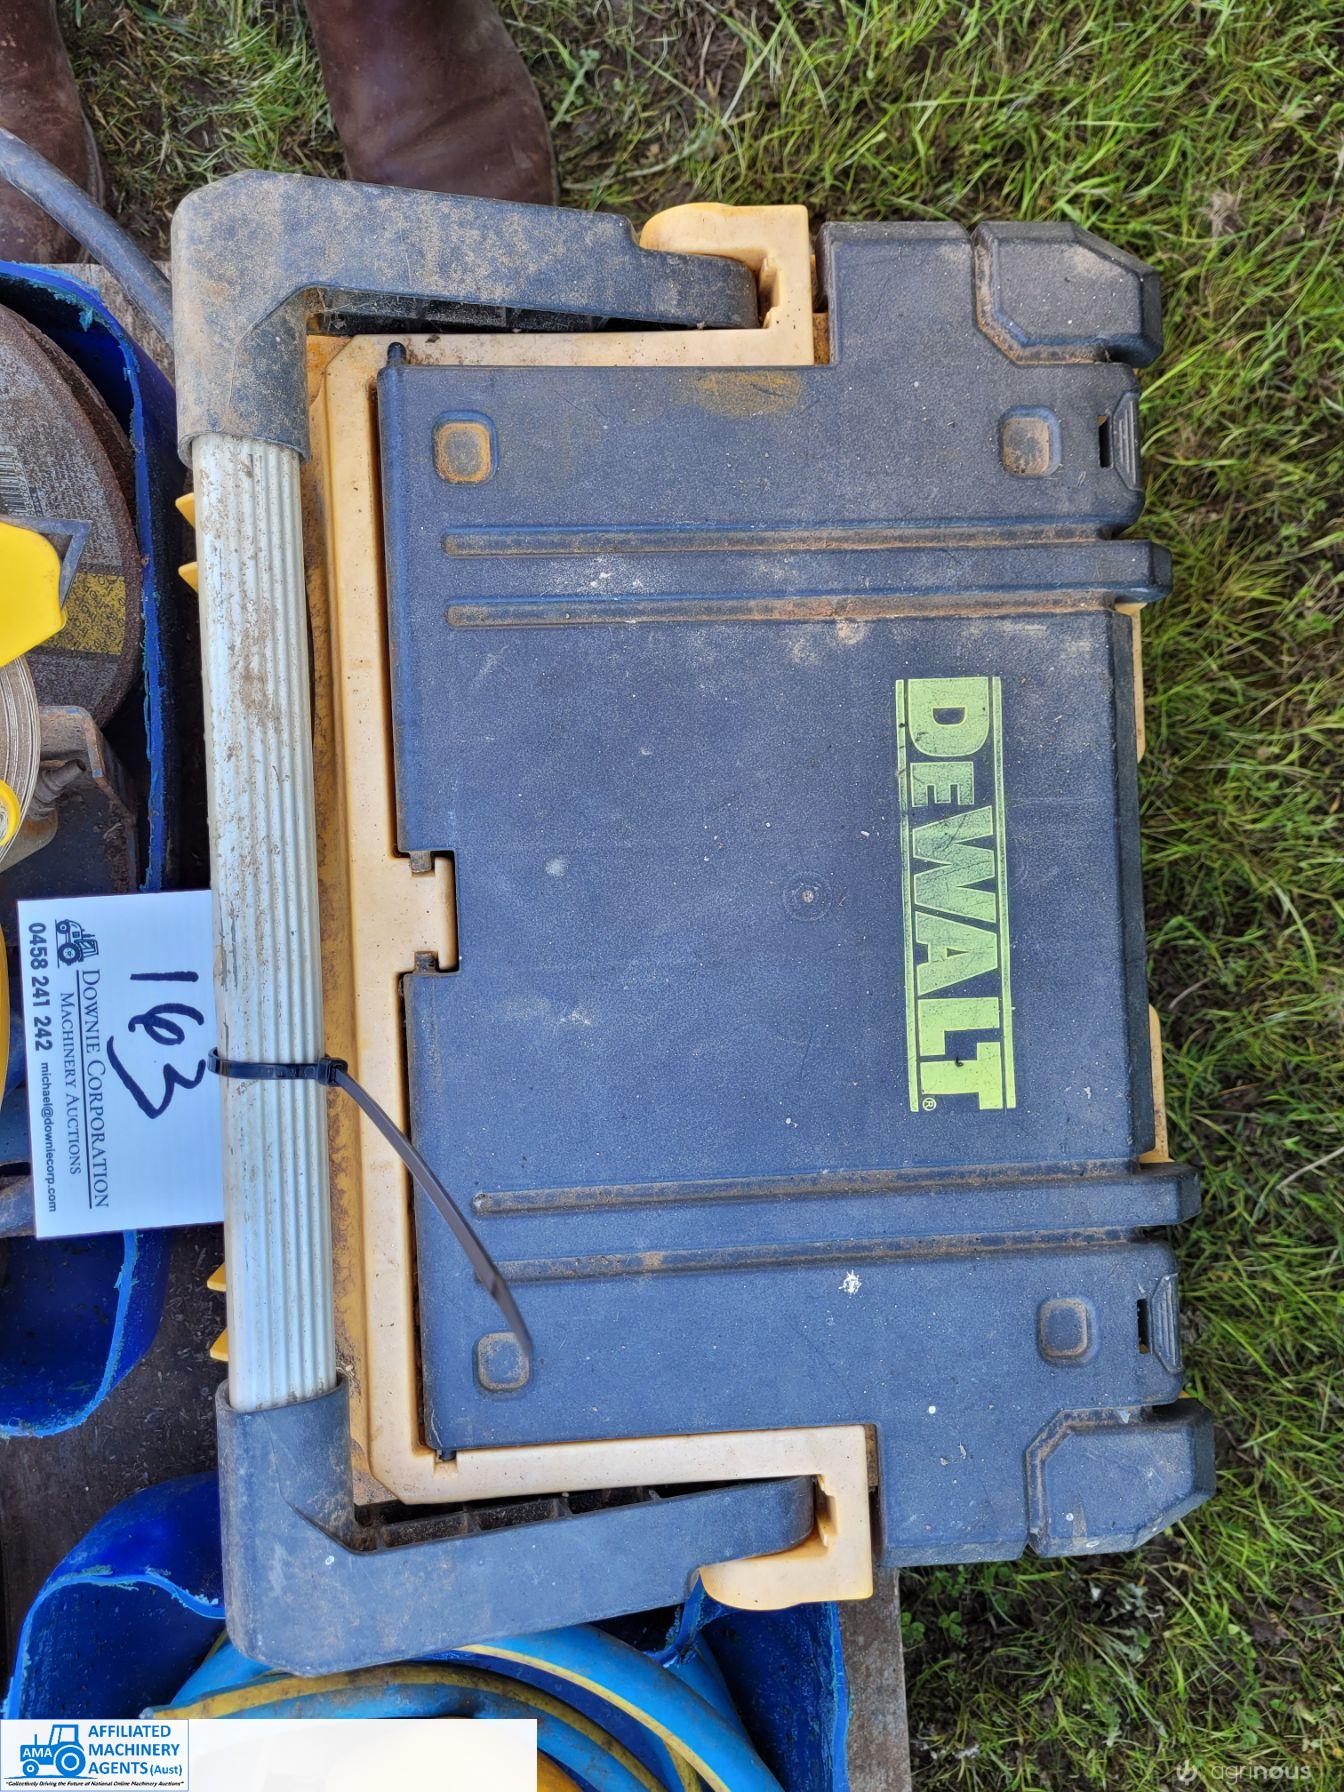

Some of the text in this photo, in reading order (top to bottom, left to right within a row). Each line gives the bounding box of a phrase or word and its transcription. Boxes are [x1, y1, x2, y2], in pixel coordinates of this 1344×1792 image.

[907, 676, 1003, 1110] DEWALT
[28, 922, 57, 1213] 0458 241 242 michael@downiecorp.com
[60, 992, 82, 1175] MACHINERY AUCTIONS
[82, 969, 109, 1208] DOWNIE CORPORATION
[106, 970, 207, 1120] 163
